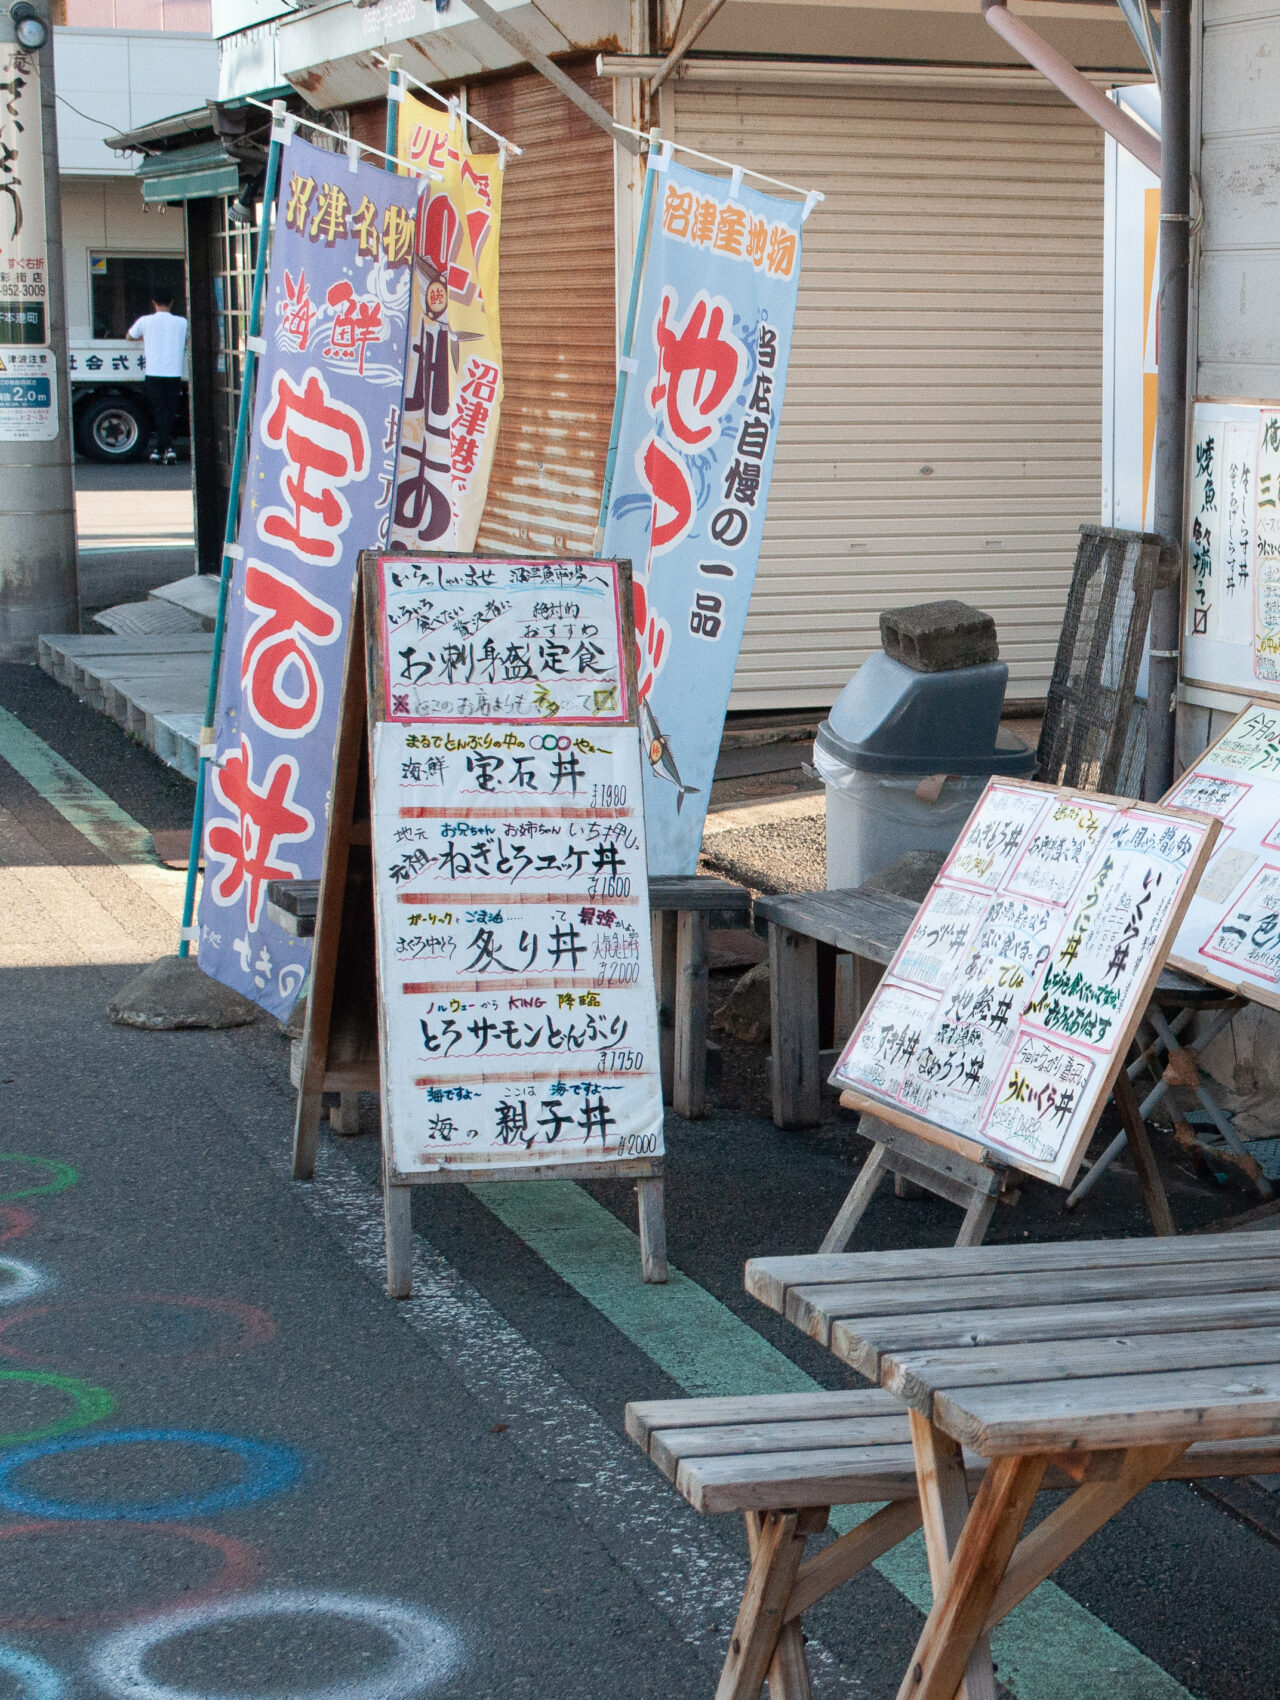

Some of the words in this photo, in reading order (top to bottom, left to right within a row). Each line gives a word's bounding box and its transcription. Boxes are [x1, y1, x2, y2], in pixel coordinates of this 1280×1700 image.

[285, 171, 416, 268] 沼津名物
[663, 184, 796, 277] 沼津産地物
[8, 258, 44, 270] すぐ右折
[13, 387, 36, 401] 2.0
[691, 325, 777, 637] 当店自慢の一品
[391, 565, 498, 590] いらっしゃいませ
[509, 565, 609, 588] 沼津魚市場へ
[389, 599, 433, 625] いろいろ
[416, 605, 465, 633] 食べたい
[524, 624, 599, 638] おすすめ
[532, 600, 580, 620] 絶対的
[399, 637, 616, 684] お刺身盛定食
[401, 755, 449, 785] 海鮮
[466, 751, 586, 799] 宝石丼
[393, 828, 429, 842] 地元
[440, 823, 496, 838] お兄ちゃん
[503, 821, 562, 836] お姉ちゃん
[438, 837, 626, 884] ねぎとろユッケ丼
[466, 923, 587, 972] 炙り丼
[1101, 867, 1162, 985] いくら丼
[233, 931, 305, 998] せきの
[425, 999, 499, 1014] ノルウェーから
[508, 994, 547, 1009] KING
[557, 991, 601, 1011] 降臨
[419, 1013, 628, 1057] とろサーモンどんぶり
[503, 1085, 537, 1097] ここは
[917, 1045, 985, 1095] なめろう丼
[1000, 1067, 1075, 1128] うにいくら丼
[428, 1113, 479, 1141] 海の
[495, 1095, 617, 1150] 親子丼
